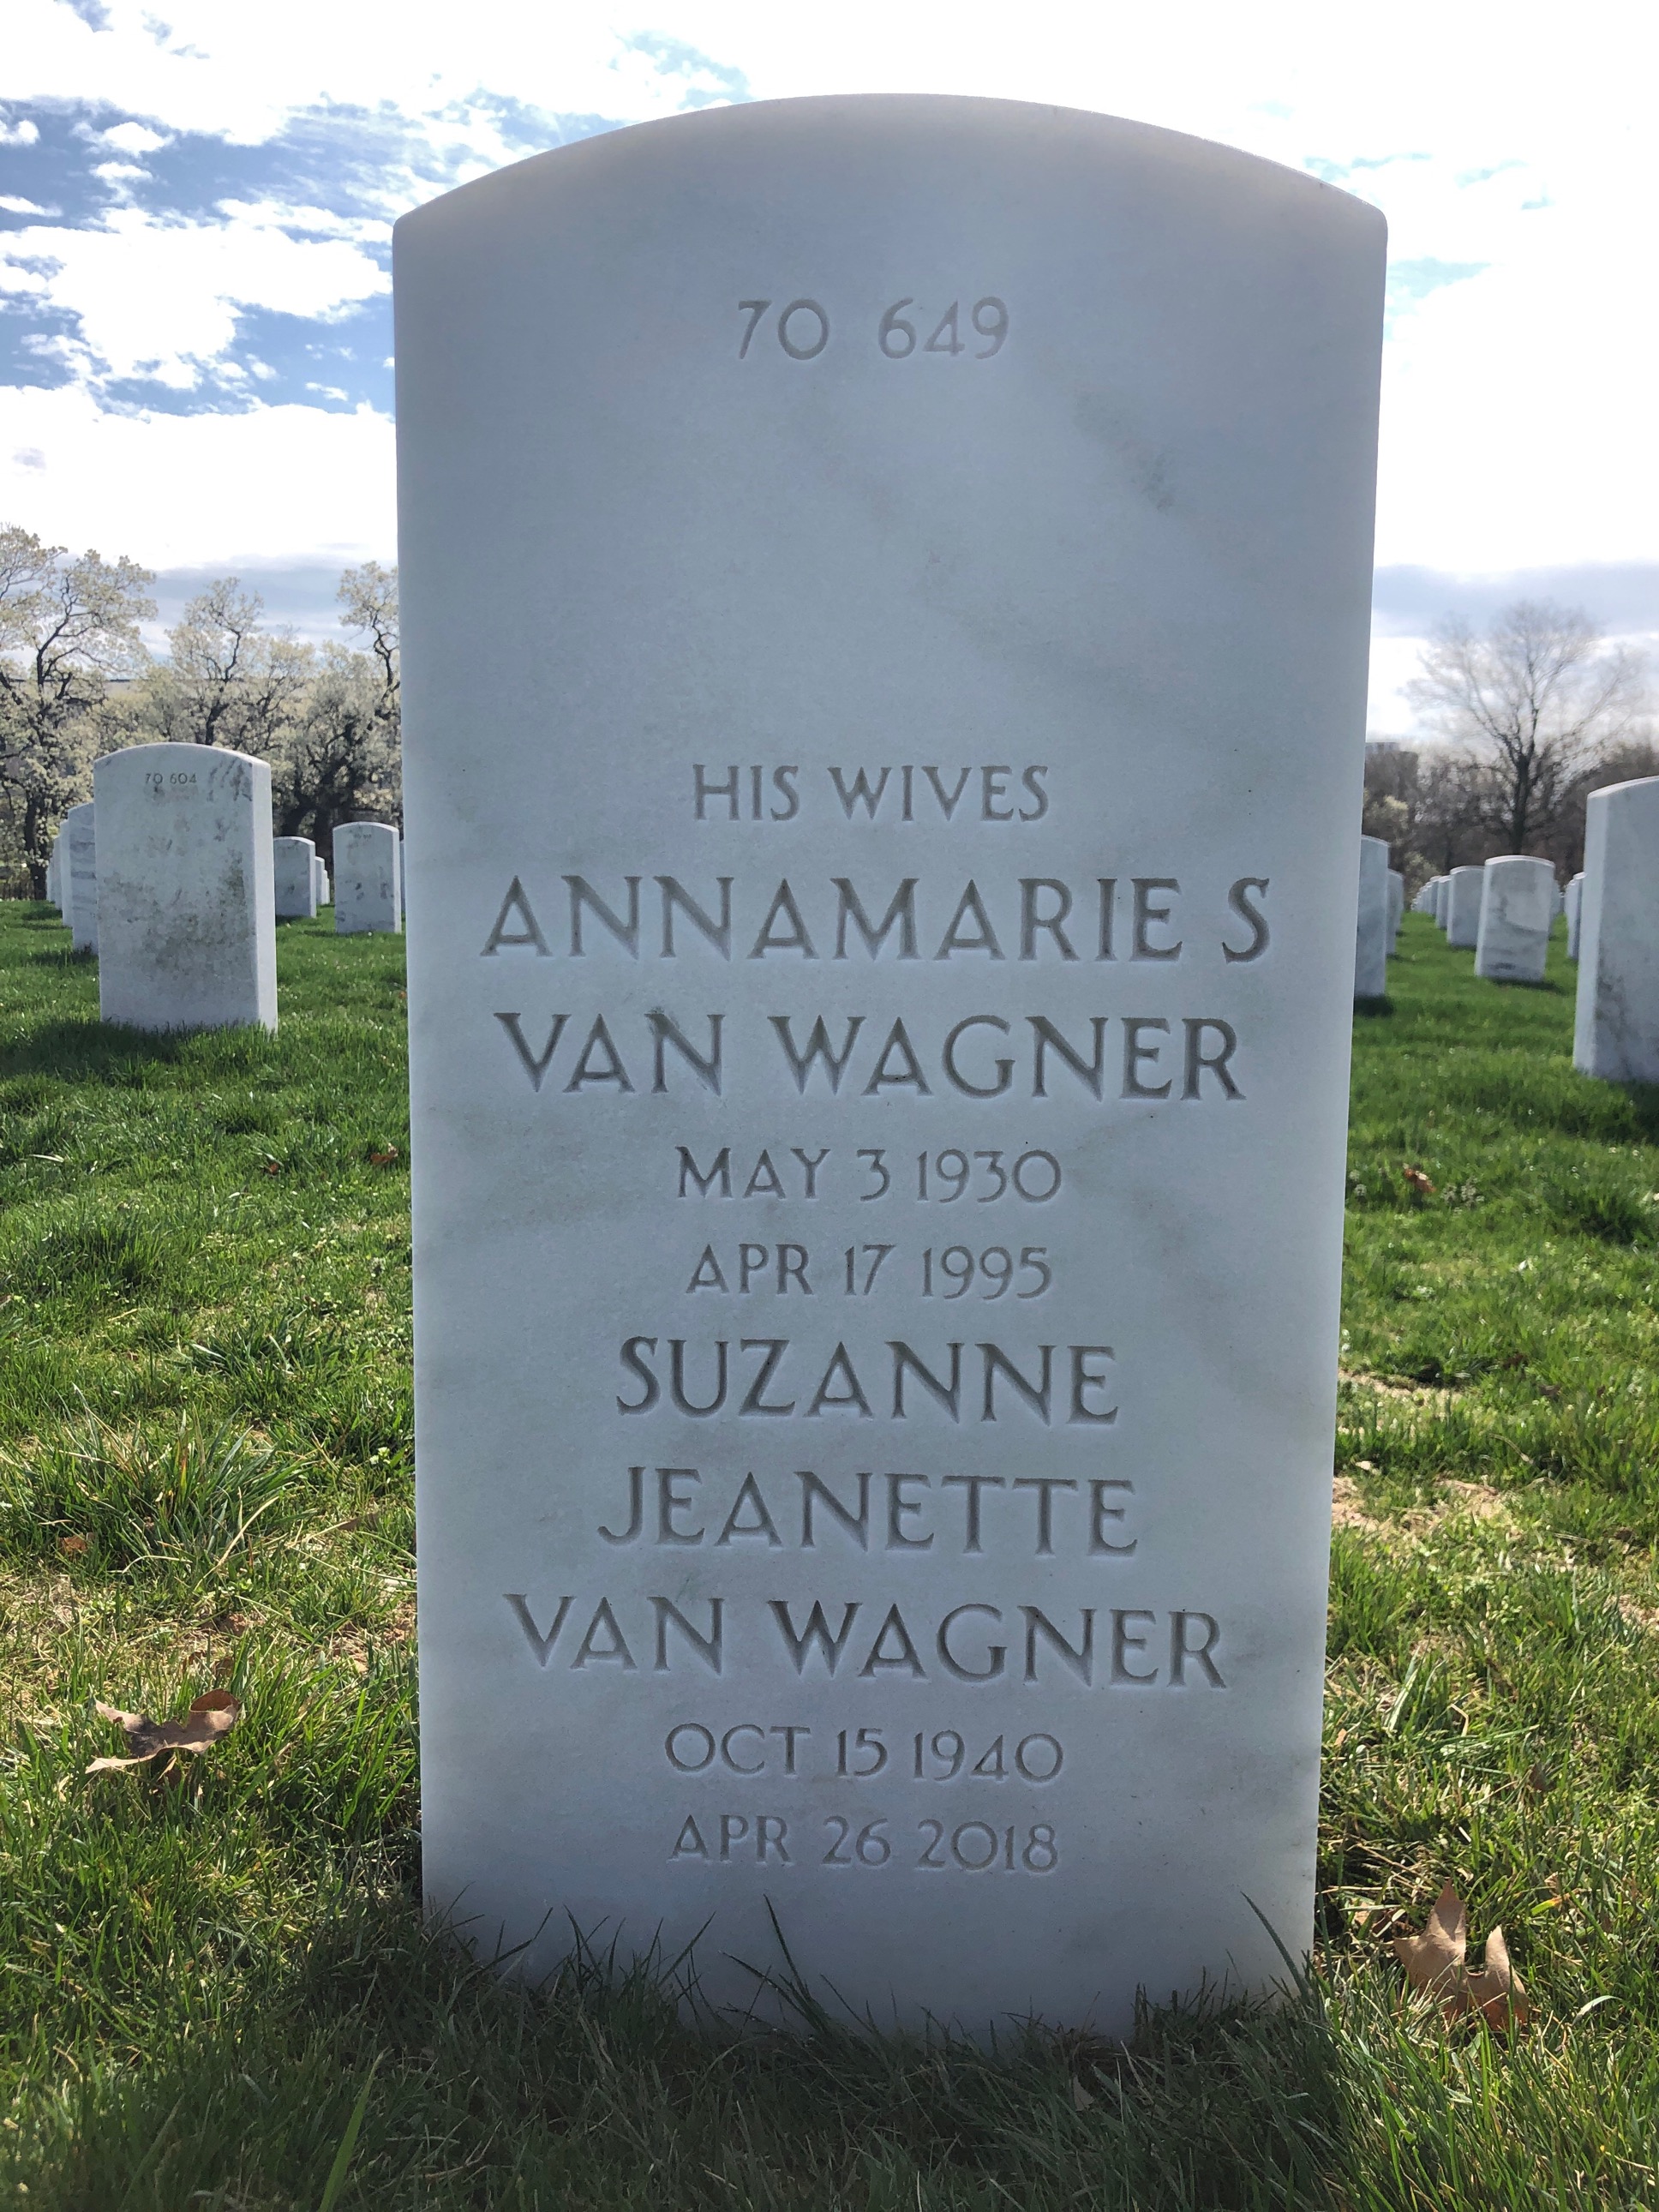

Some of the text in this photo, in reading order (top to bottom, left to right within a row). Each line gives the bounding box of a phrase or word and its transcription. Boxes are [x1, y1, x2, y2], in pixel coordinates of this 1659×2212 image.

[739, 297, 1009, 360] 70 649
[145, 772, 197, 784] 70 604
[692, 763, 1050, 823] HIS WIVES
[481, 875, 1270, 964] ANNAMARIE S
[493, 1011, 1246, 1100] VAN WAGNER
[676, 1146, 1063, 1202] MAY 3 1930
[686, 1244, 1052, 1300] APR 17 1995
[616, 1335, 1118, 1425] SUZANNE
[597, 1466, 1137, 1557] JEANETTE
[503, 1593, 1227, 1688] VAN WAGNER
[665, 1723, 1063, 1783] OCT 15 1940
[668, 1813, 1057, 1873] APR 26 2018
